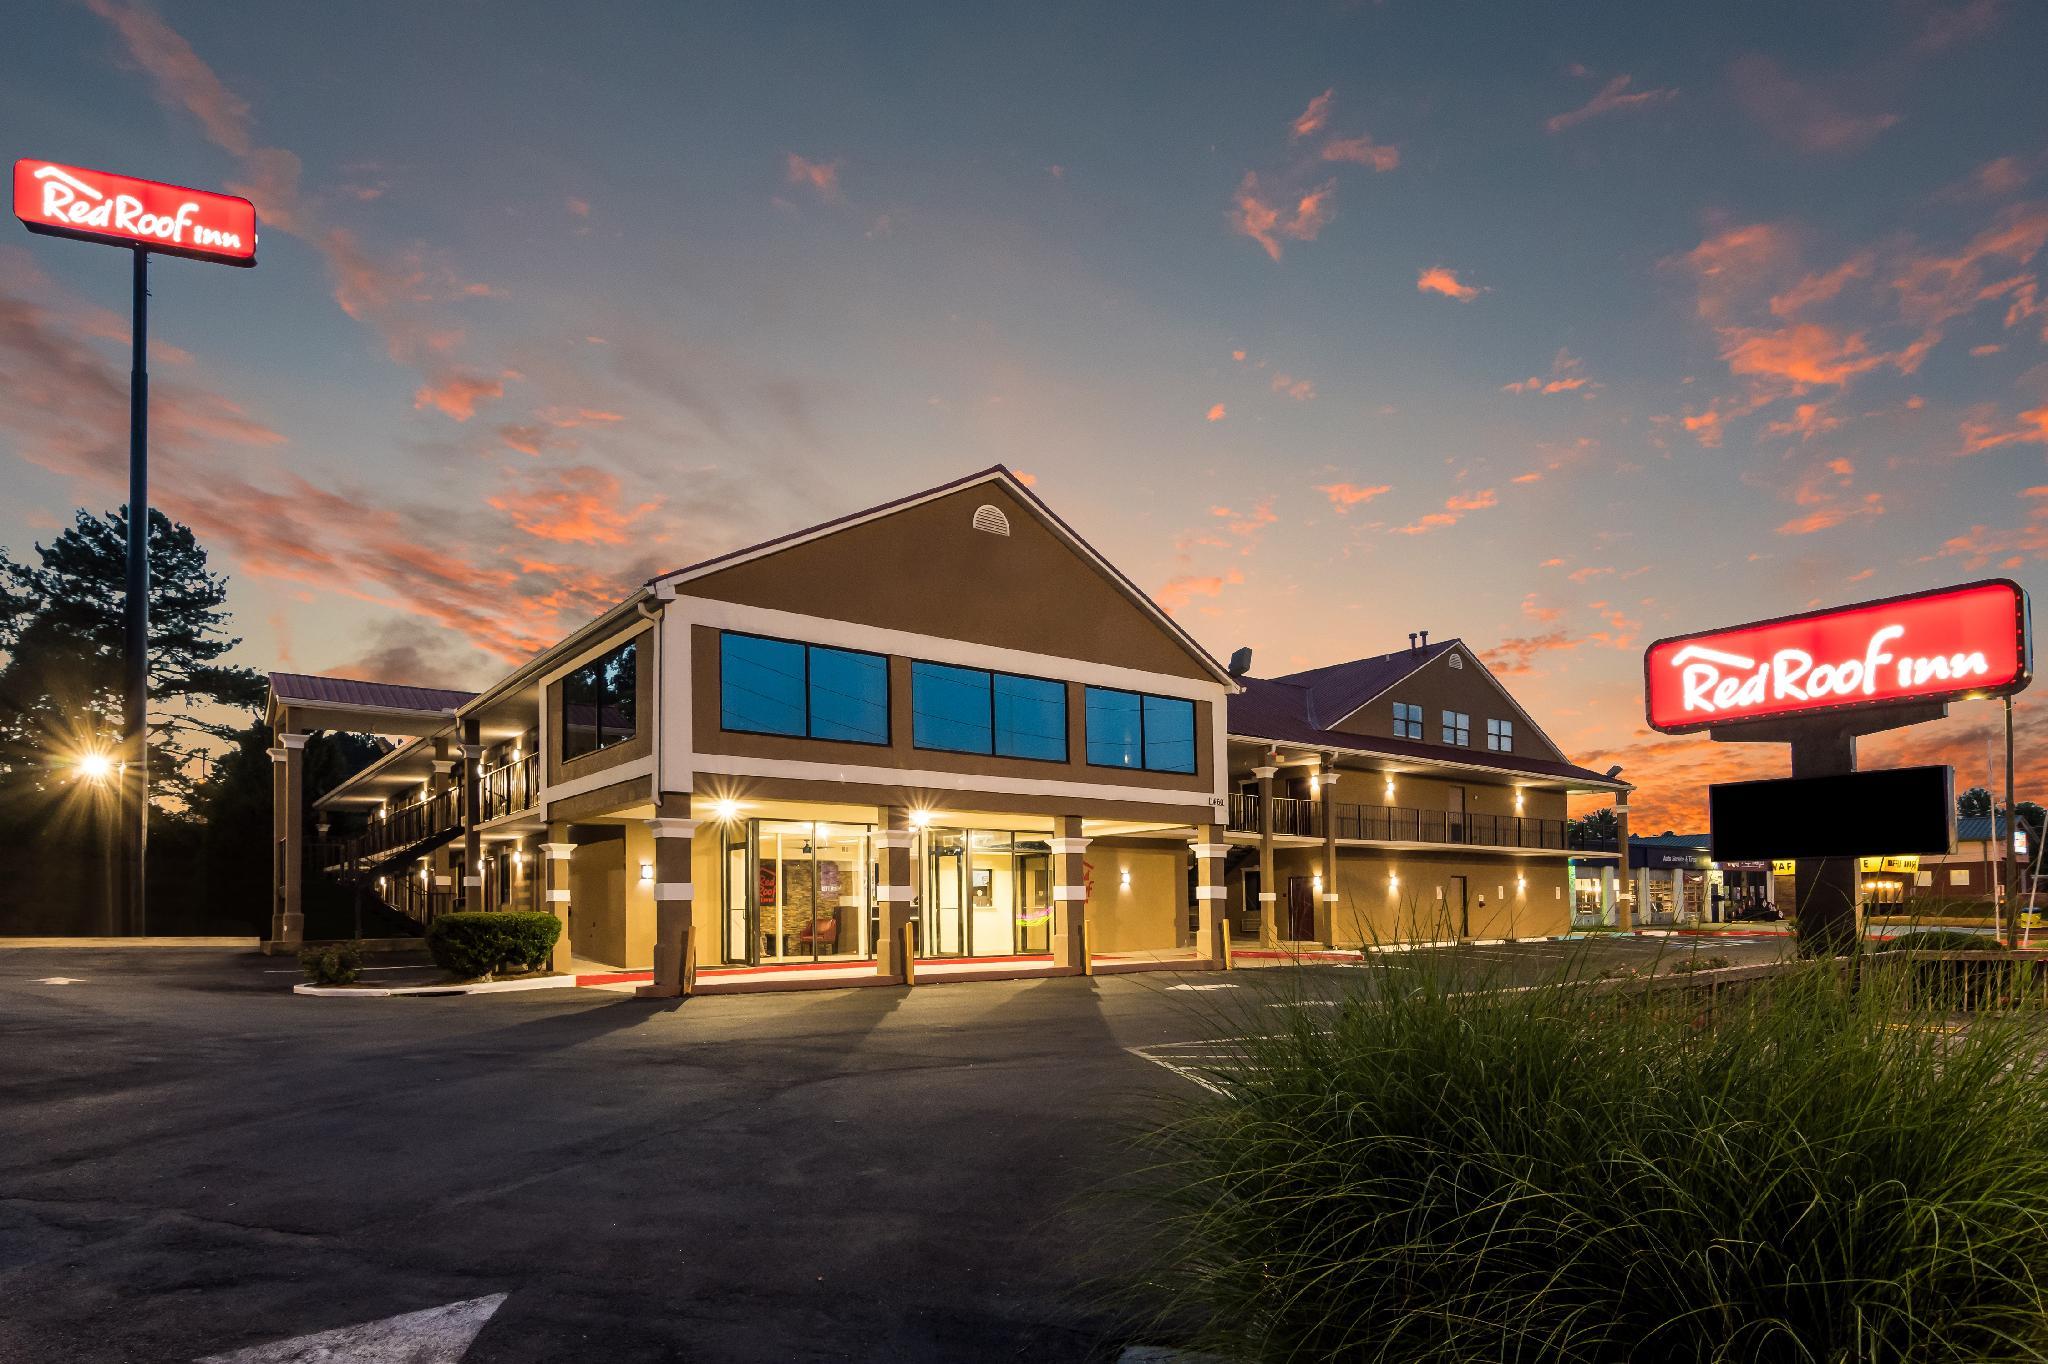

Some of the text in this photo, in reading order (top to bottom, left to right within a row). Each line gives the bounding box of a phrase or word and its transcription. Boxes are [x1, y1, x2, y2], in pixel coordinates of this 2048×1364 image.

[42, 180, 113, 227] Red
[114, 194, 200, 243] Roof
[1682, 662, 1770, 713] Red
[1772, 624, 1905, 701] Roof
